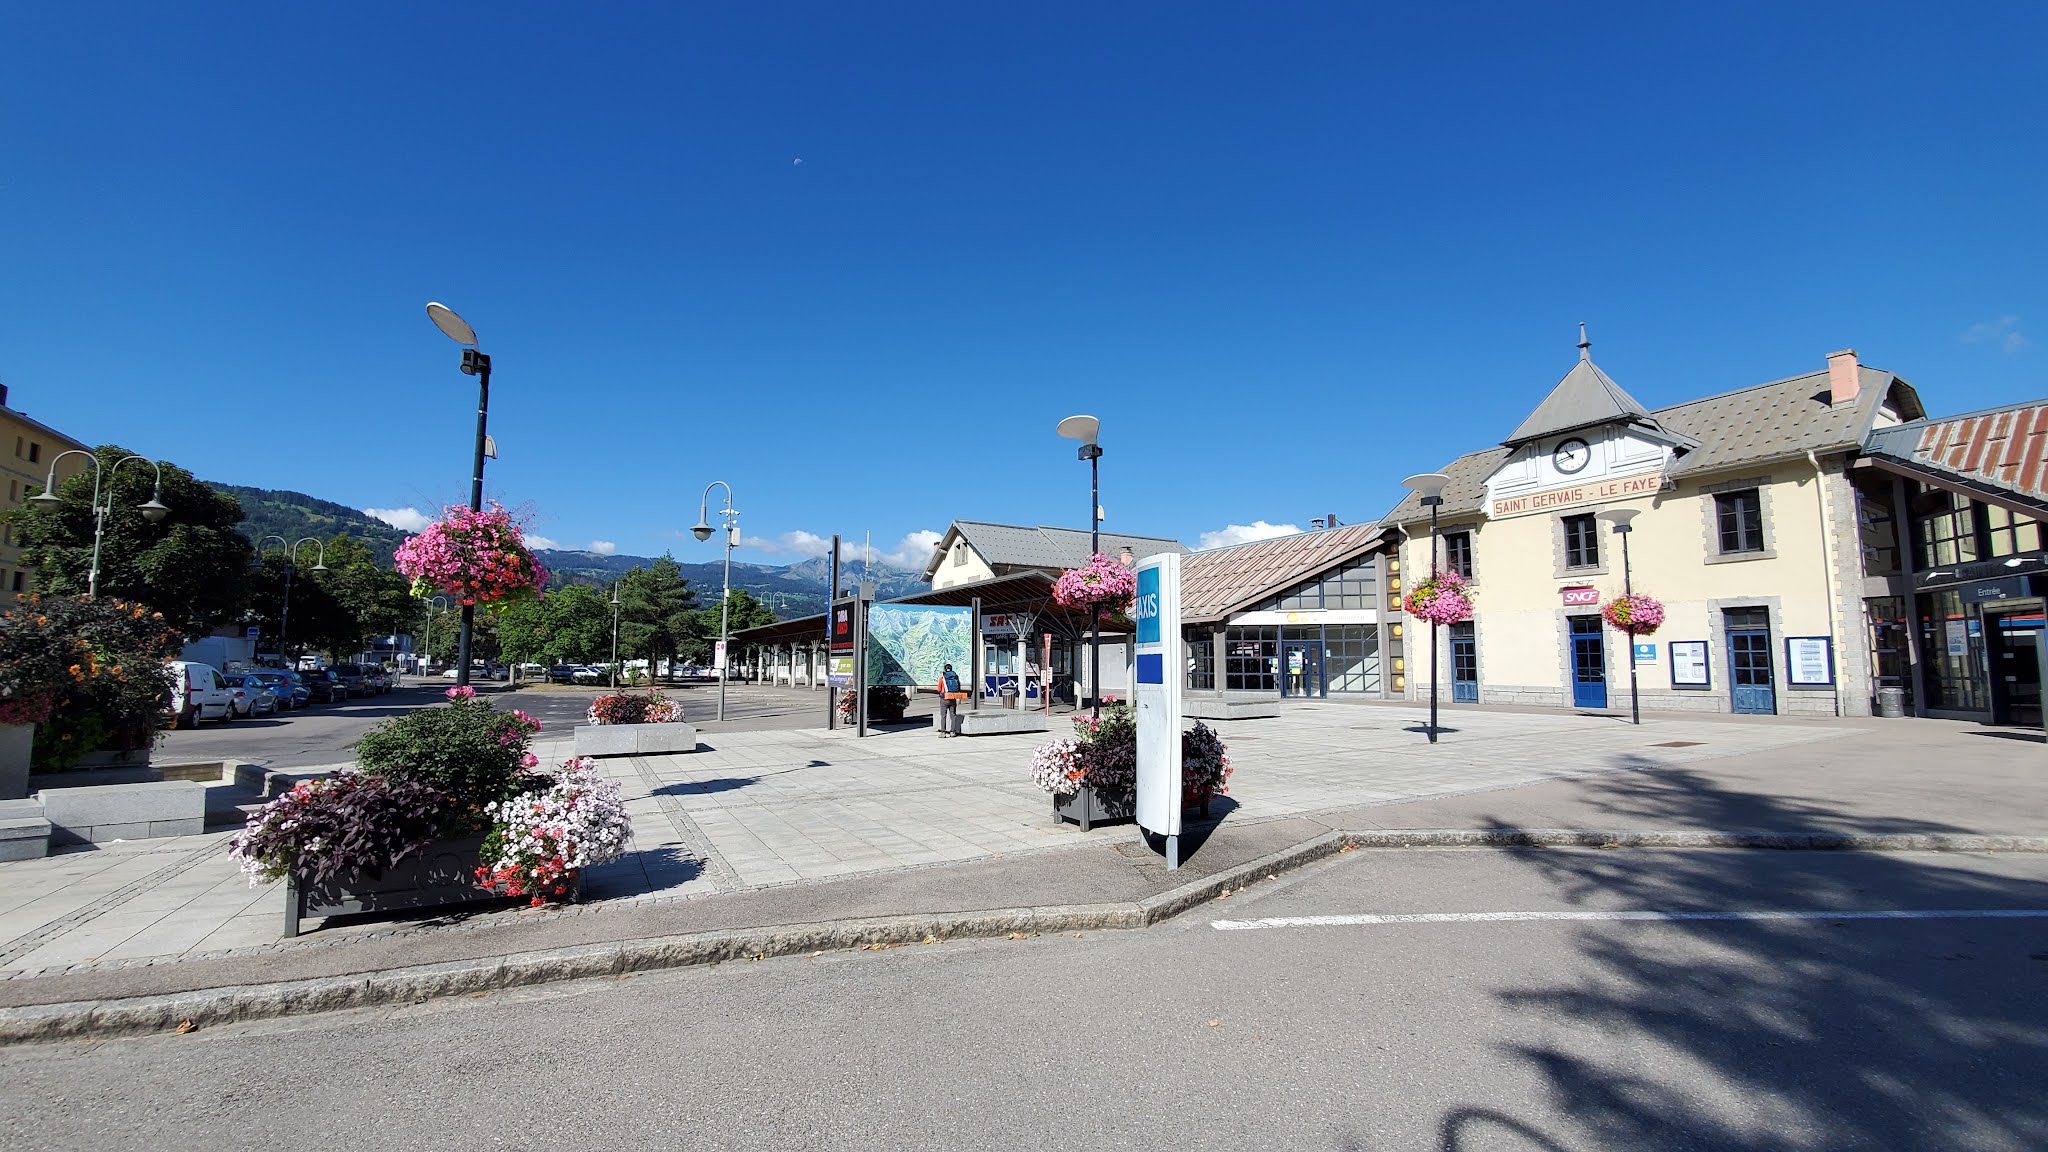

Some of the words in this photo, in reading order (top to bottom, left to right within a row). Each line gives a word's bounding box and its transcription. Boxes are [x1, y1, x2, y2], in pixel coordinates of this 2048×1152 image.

[1495, 498, 1528, 514] SAINT
[1532, 489, 1583, 508] GERVAIS
[1600, 484, 1618, 496] LE
[1624, 476, 1663, 493] FAYE
[1564, 591, 1598, 603] SNCF
[1977, 586, 2001, 597] Entrée
